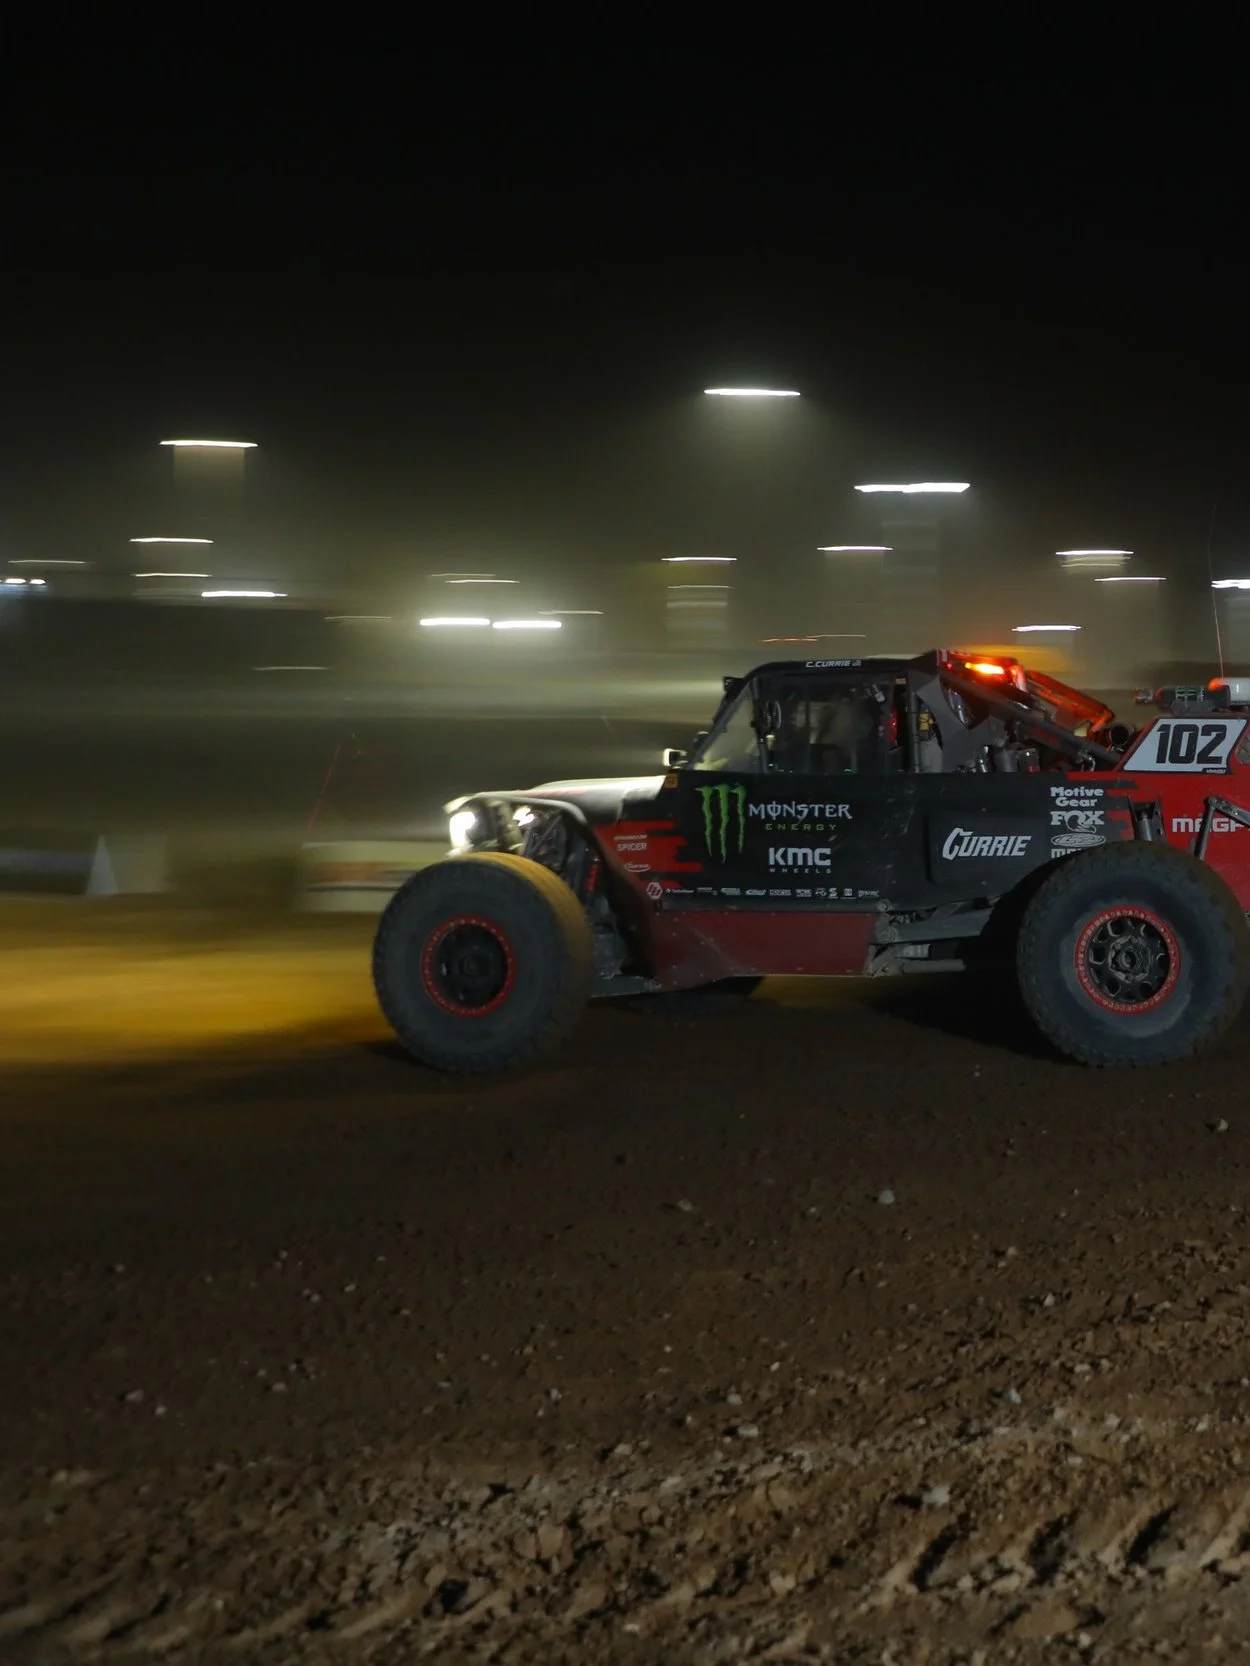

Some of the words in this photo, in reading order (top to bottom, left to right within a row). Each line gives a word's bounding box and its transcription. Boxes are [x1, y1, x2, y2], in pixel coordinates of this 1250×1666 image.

[1156, 723, 1228, 764] 102
[1050, 786, 1104, 797] Motive
[749, 800, 853, 821] MONSTER
[1055, 797, 1099, 808] Gear
[765, 823, 838, 831] ENERGY
[1050, 810, 1105, 830] FOX
[616, 842, 648, 852] SPICER
[942, 827, 1032, 861] CURRIE
[768, 847, 832, 866] KMC
